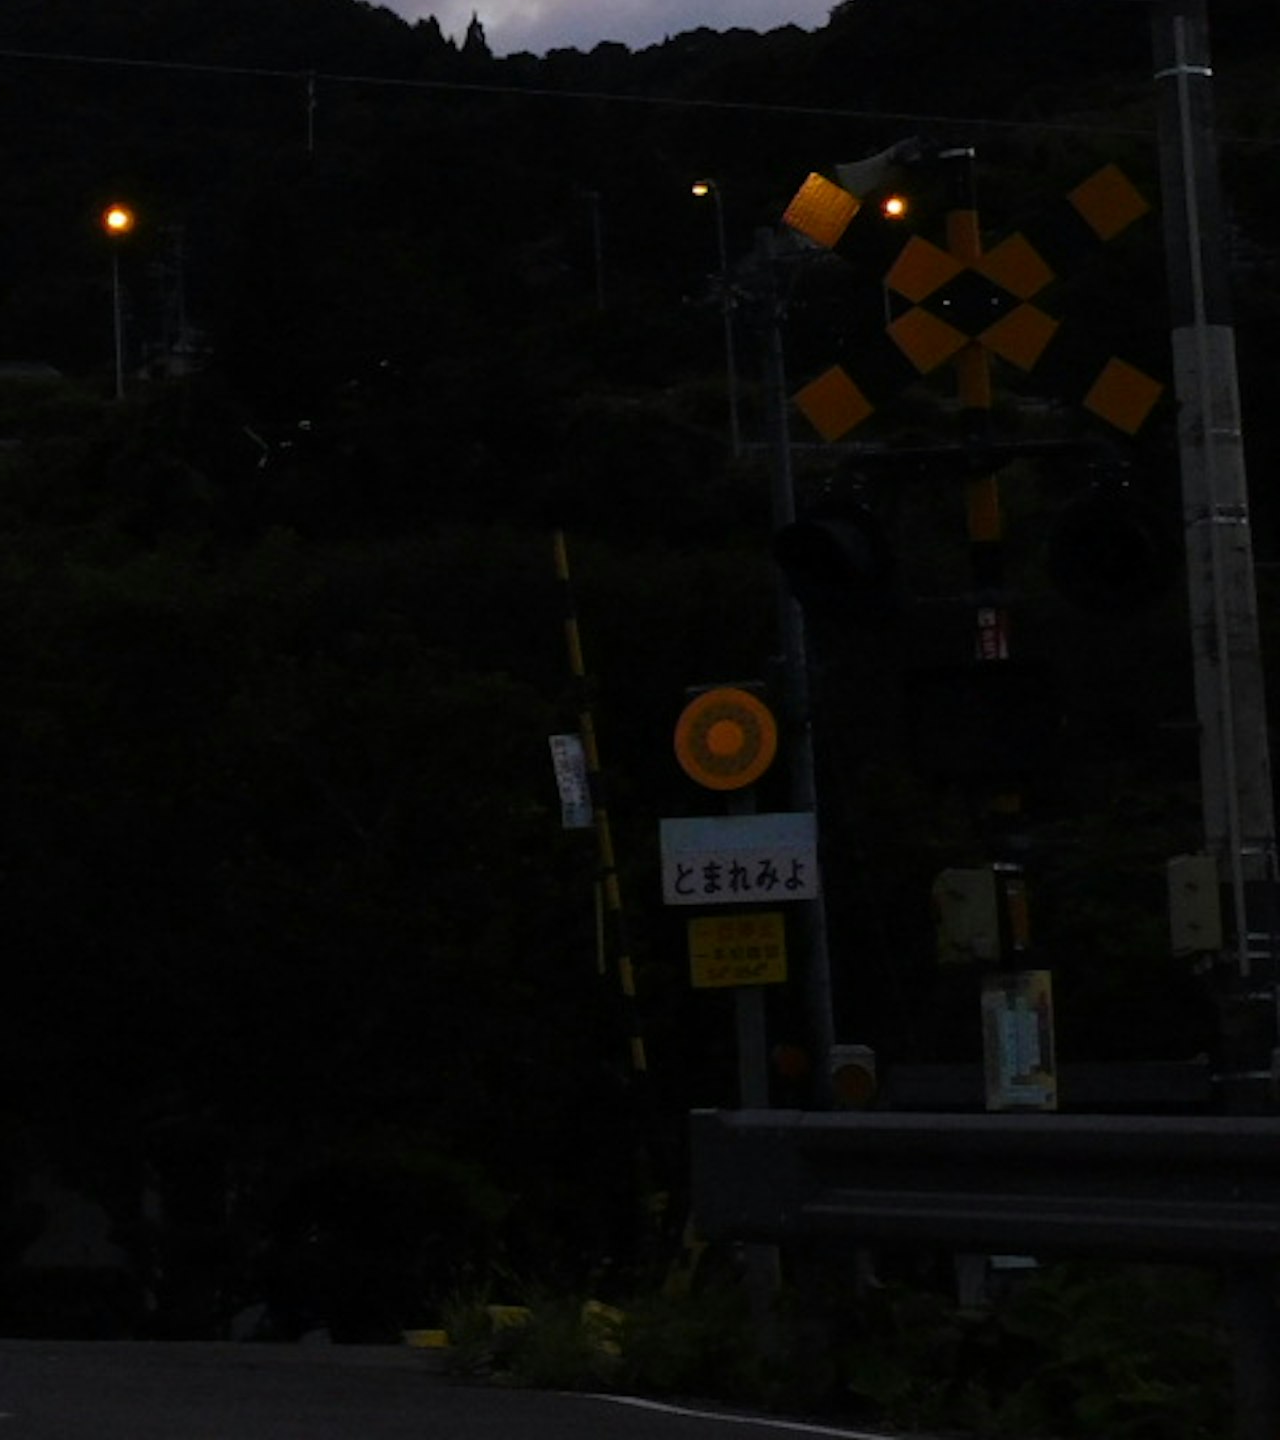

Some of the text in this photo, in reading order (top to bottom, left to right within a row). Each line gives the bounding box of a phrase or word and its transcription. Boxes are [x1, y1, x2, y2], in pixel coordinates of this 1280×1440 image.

[675, 859, 805, 895] とまれみよ
